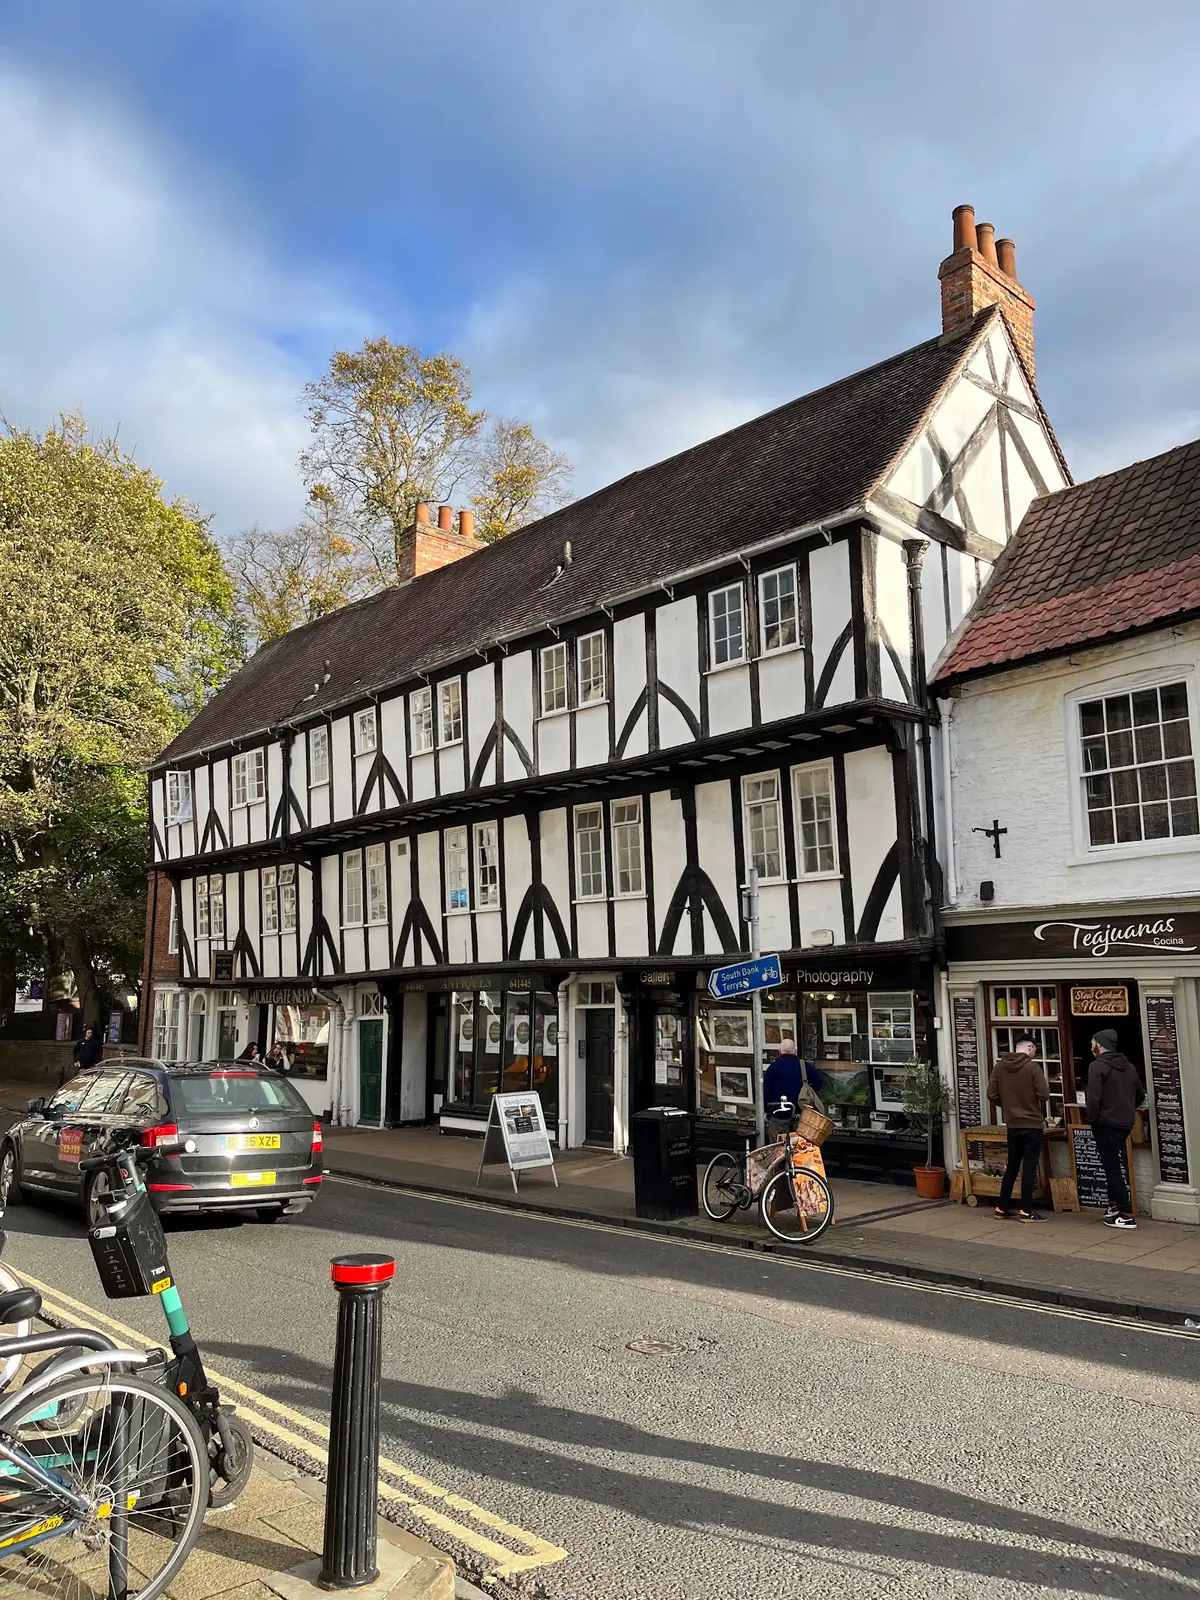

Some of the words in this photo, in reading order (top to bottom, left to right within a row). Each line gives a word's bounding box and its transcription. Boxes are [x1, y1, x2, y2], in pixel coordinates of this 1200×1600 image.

[1034, 918, 1178, 957] Teajuanas
[1153, 937, 1184, 946] Cocina
[640, 971, 670, 985] Gallery
[721, 970, 741, 982] South
[741, 965, 760, 976] Bank
[797, 968, 874, 986] Photography
[441, 976, 491, 990] ANTIQUES
[292, 988, 315, 1004] NEWS
[1075, 990, 1094, 1000] Slow
[1095, 990, 1122, 1000] Cooked
[1081, 1000, 1116, 1012] Meals
[259, 1136, 278, 1146] XZF
[151, 1266, 166, 1276] TIER
